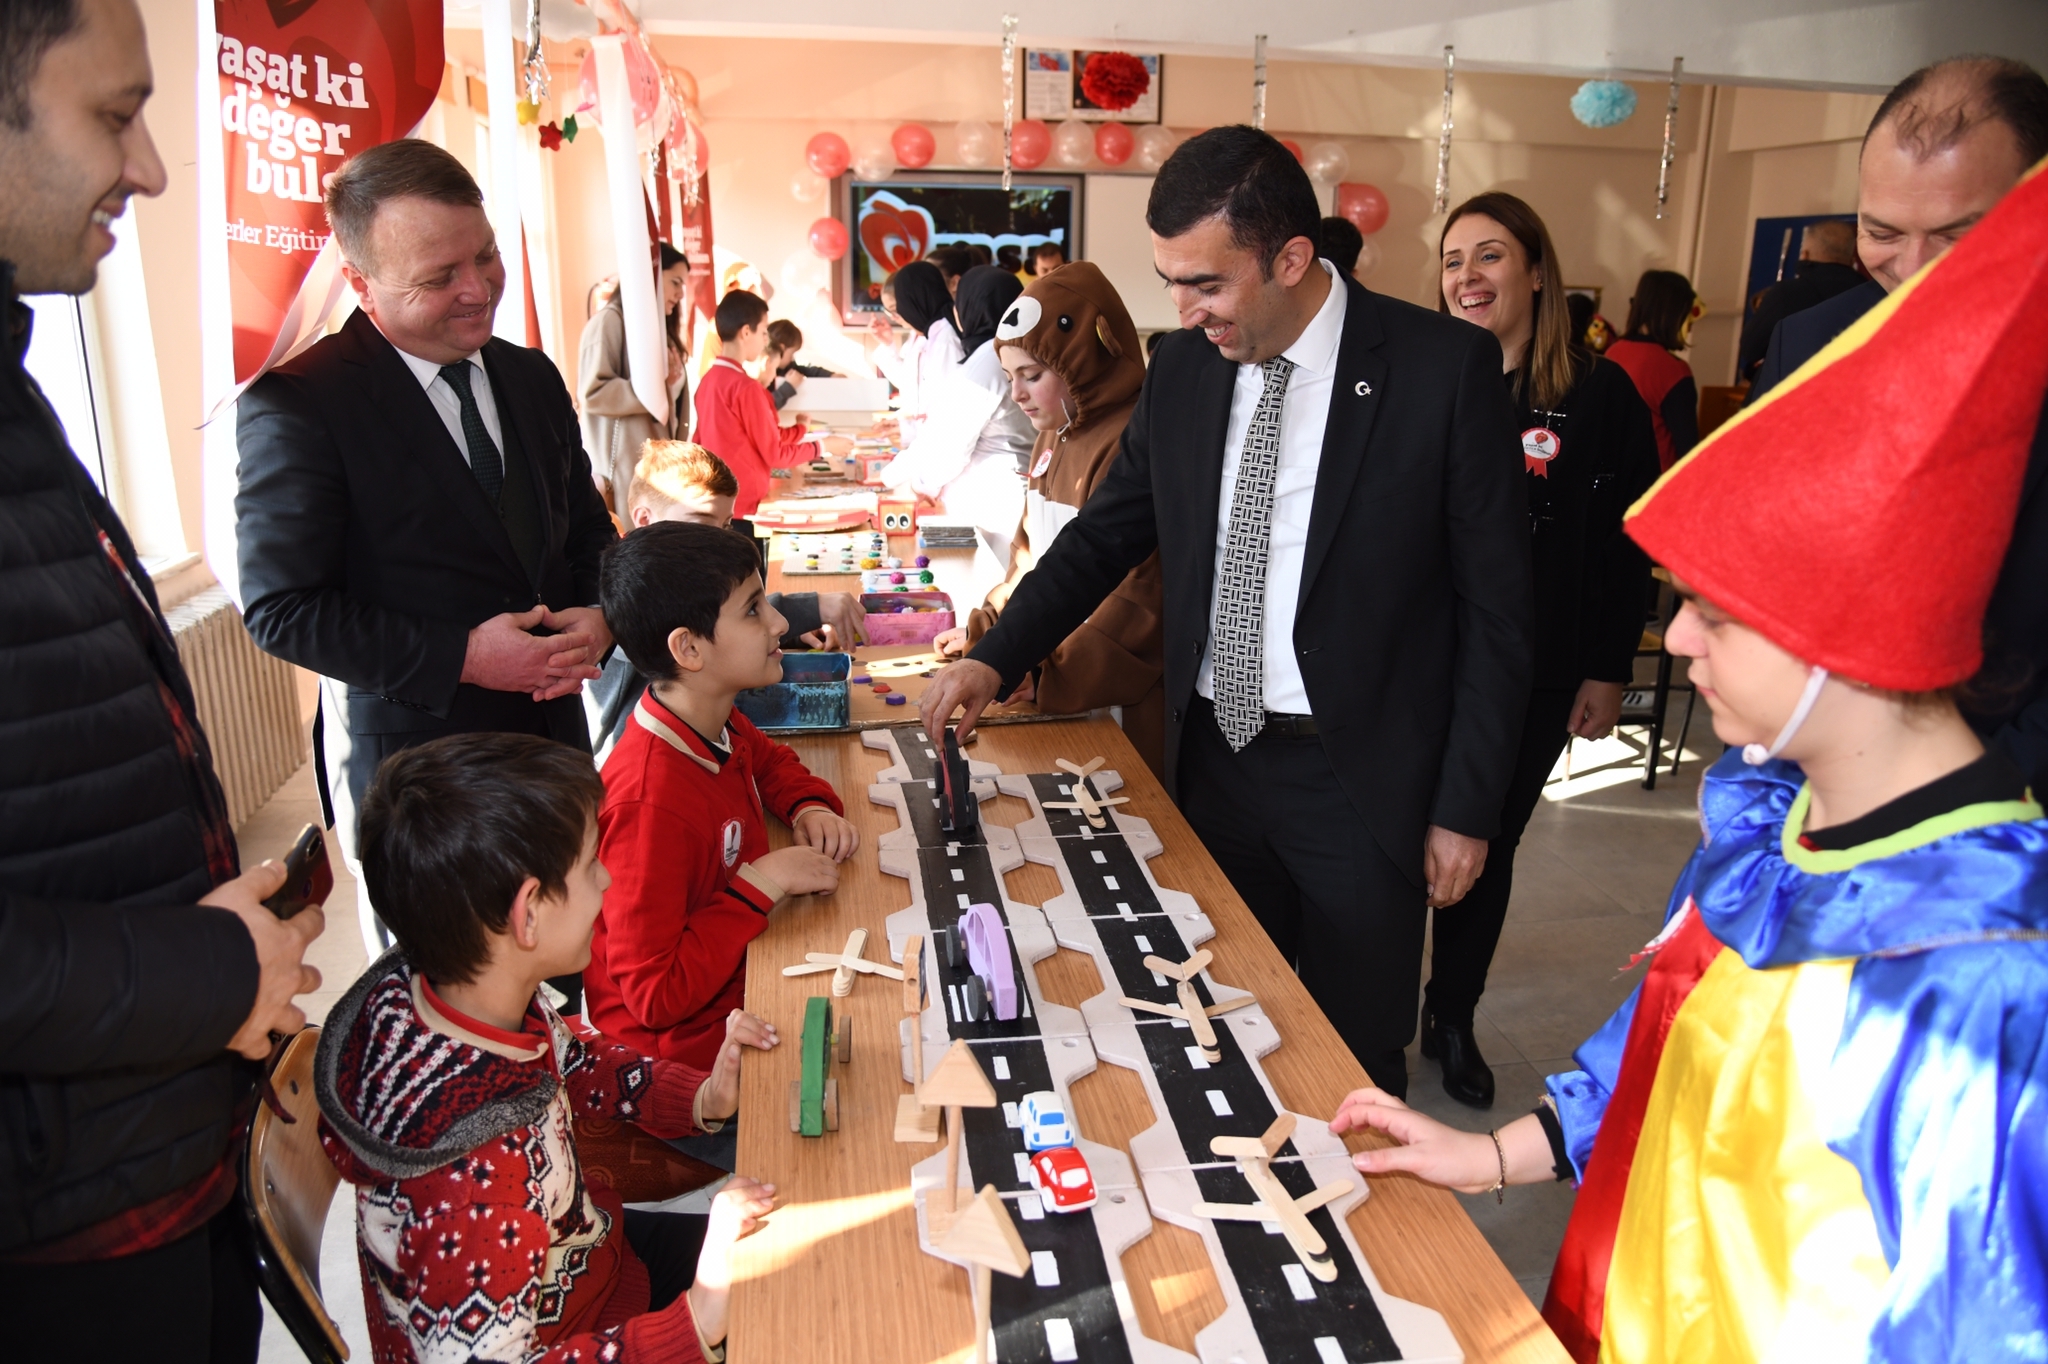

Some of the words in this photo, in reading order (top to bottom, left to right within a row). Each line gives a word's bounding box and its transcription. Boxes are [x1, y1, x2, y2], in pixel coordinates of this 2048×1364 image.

[314, 55, 369, 109] ki
[222, 82, 350, 161] değer
[246, 141, 333, 203] bul
